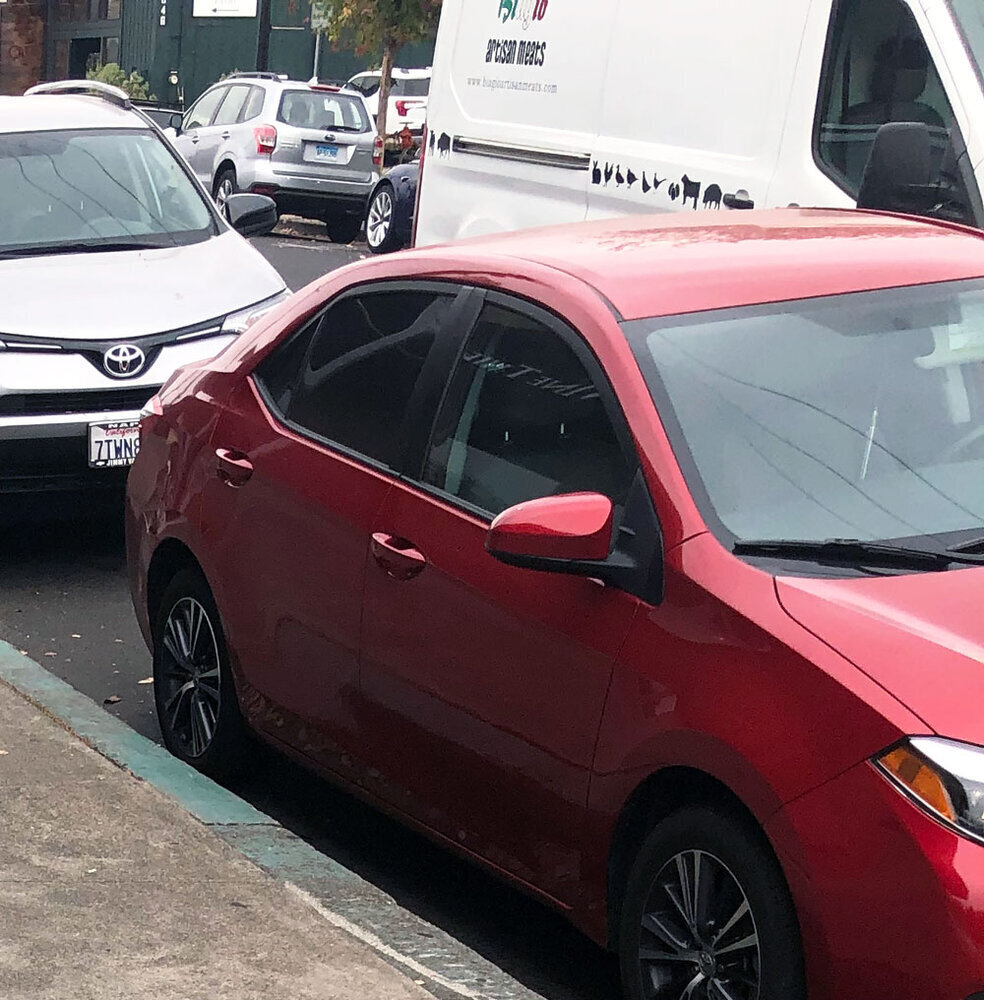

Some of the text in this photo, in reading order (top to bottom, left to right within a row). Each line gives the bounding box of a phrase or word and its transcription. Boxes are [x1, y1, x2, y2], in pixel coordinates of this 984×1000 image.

[485, 39, 546, 66] artisan meats
[95, 438, 140, 460] 7TWN8
